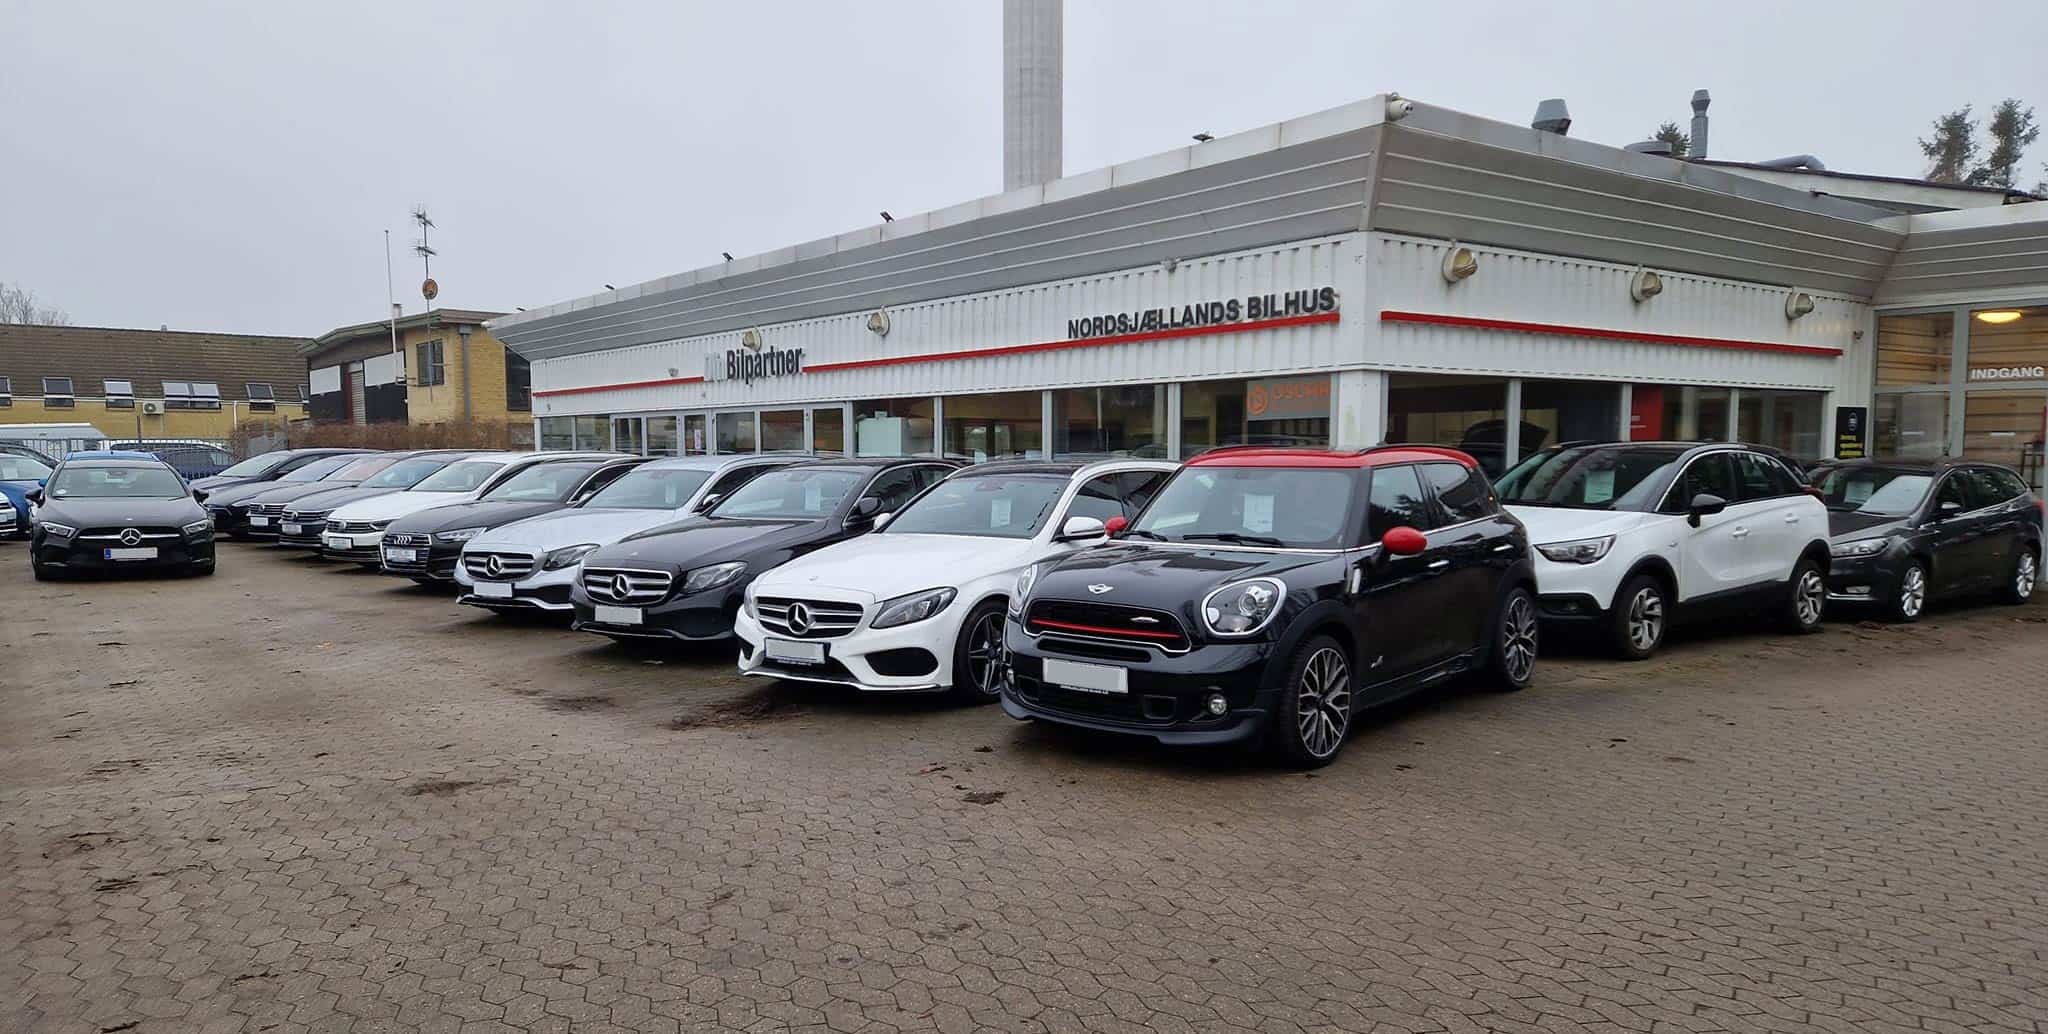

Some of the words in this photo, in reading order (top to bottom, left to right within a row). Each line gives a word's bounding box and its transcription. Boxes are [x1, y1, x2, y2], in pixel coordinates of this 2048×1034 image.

[1068, 299, 1240, 339] NORDSJÆLLANDS
[1247, 286, 1336, 319] BILHUS
[727, 346, 802, 384] Bilpartner
[1971, 366, 2044, 380] INDGANG
